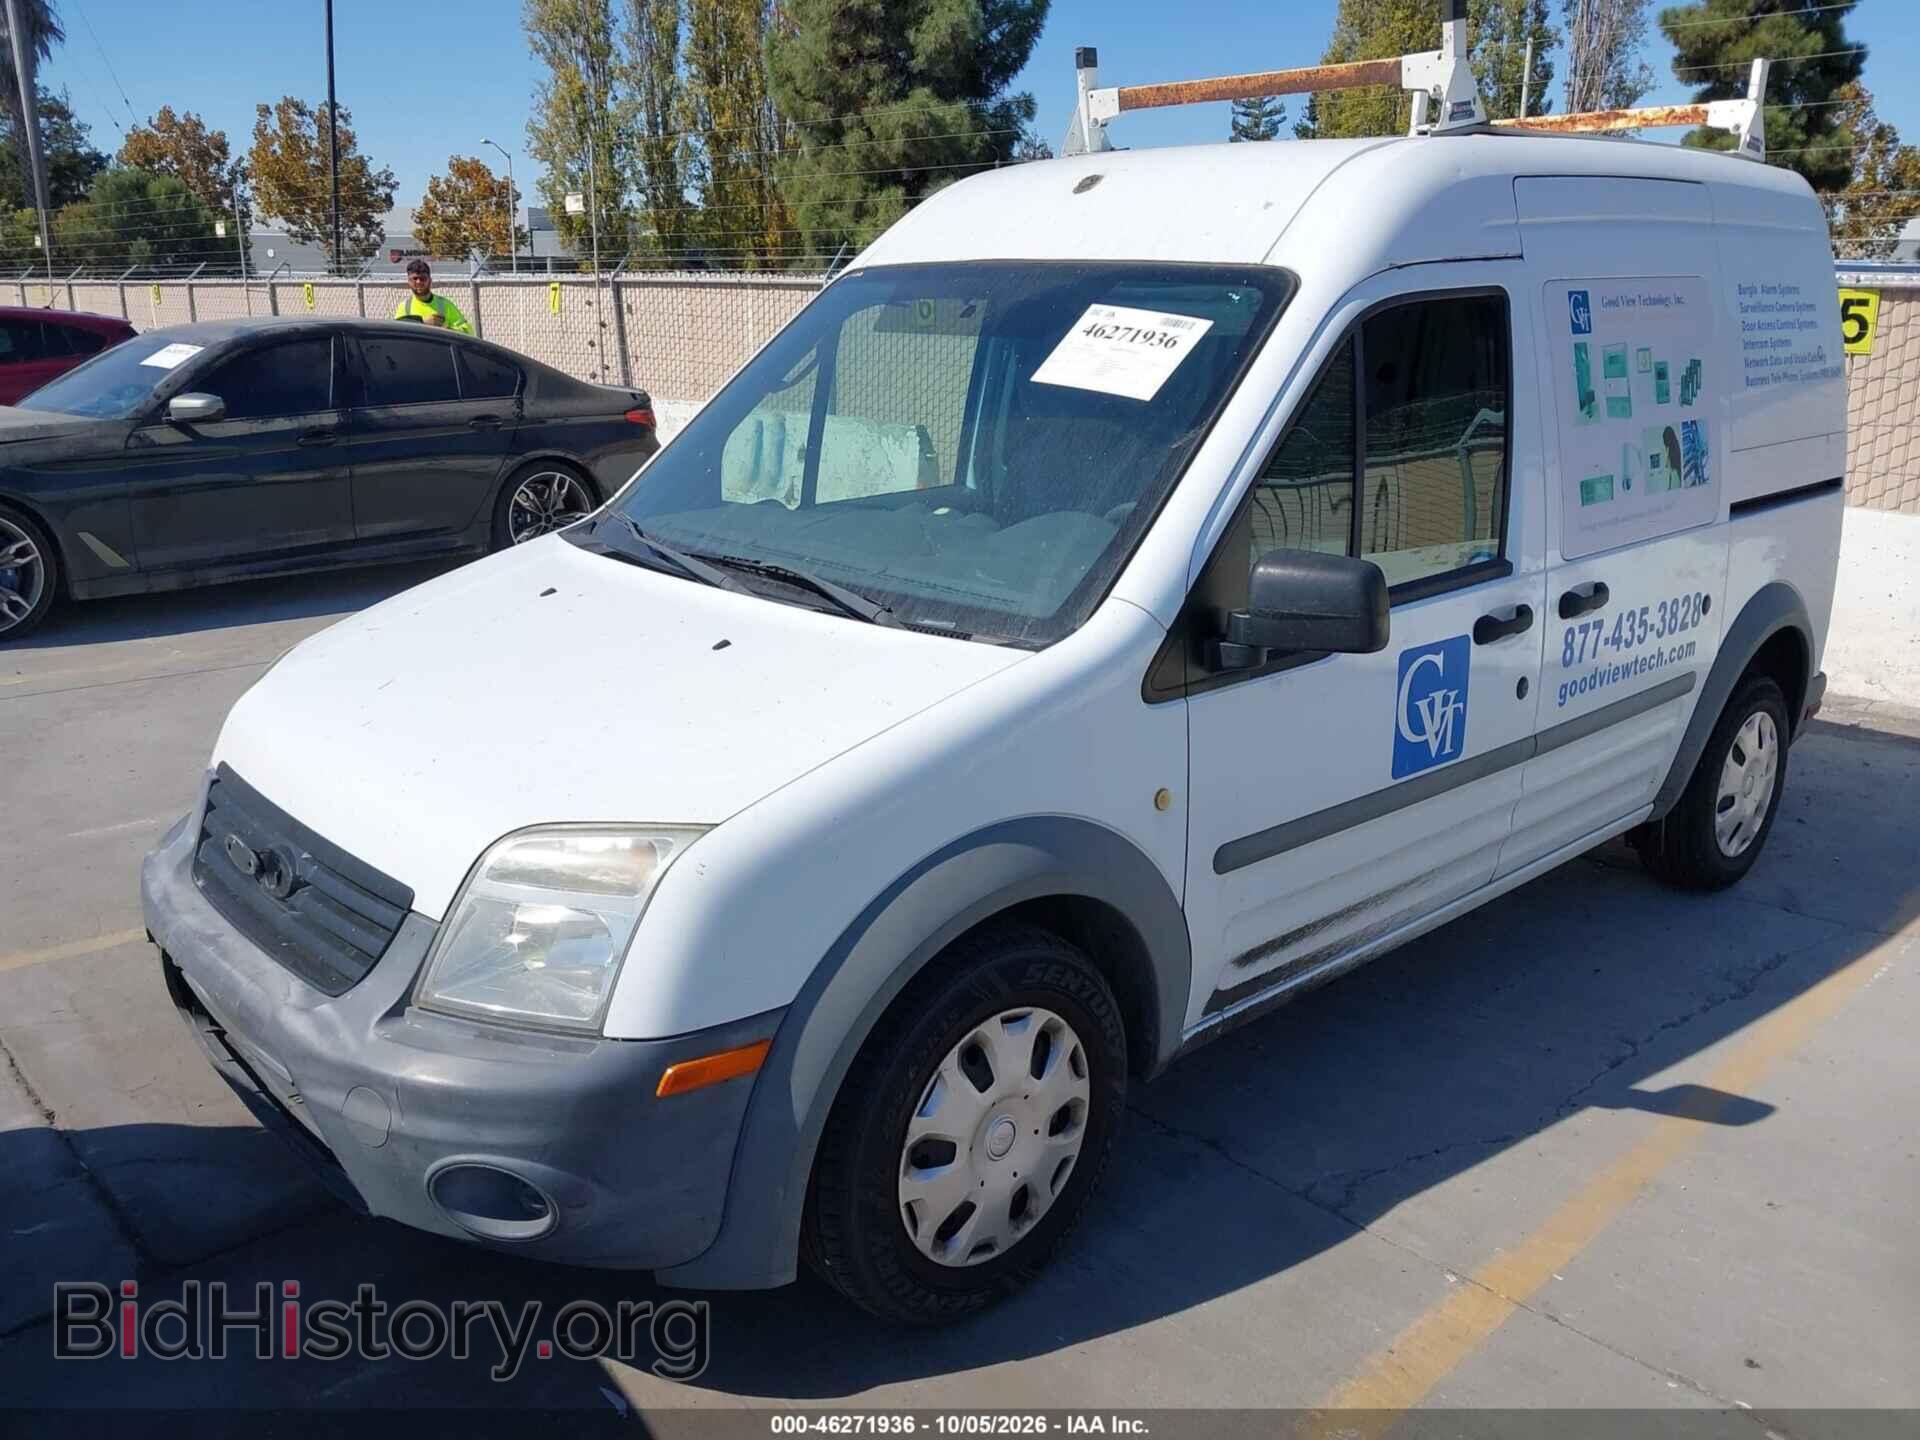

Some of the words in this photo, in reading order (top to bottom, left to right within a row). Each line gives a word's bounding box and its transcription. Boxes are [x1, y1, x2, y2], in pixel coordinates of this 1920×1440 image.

[1601, 296, 1620, 308] Good
[1841, 298, 1869, 344] 5
[1082, 322, 1179, 350] 46271936
[1562, 591, 1702, 668] 877-435-3828
[1558, 640, 1696, 707] goodviewtech.com
